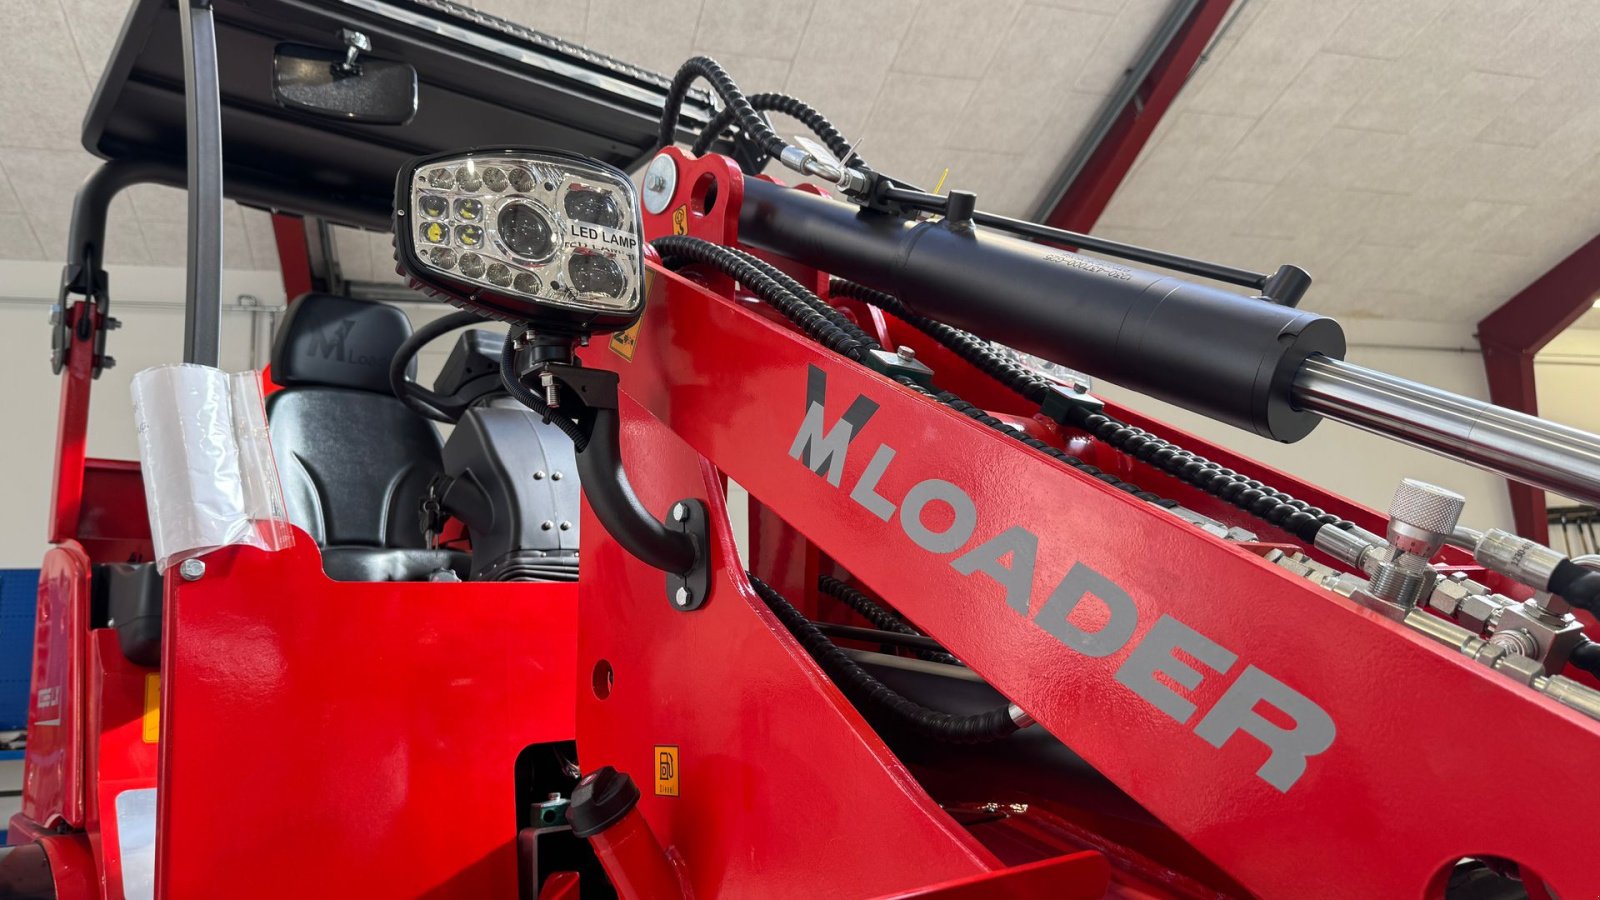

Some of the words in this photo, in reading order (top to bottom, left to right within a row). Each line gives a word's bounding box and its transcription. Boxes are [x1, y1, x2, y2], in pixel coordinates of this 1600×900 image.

[571, 224, 598, 240] LED
[602, 231, 637, 249] LAMP
[849, 443, 1337, 794] LOADER
